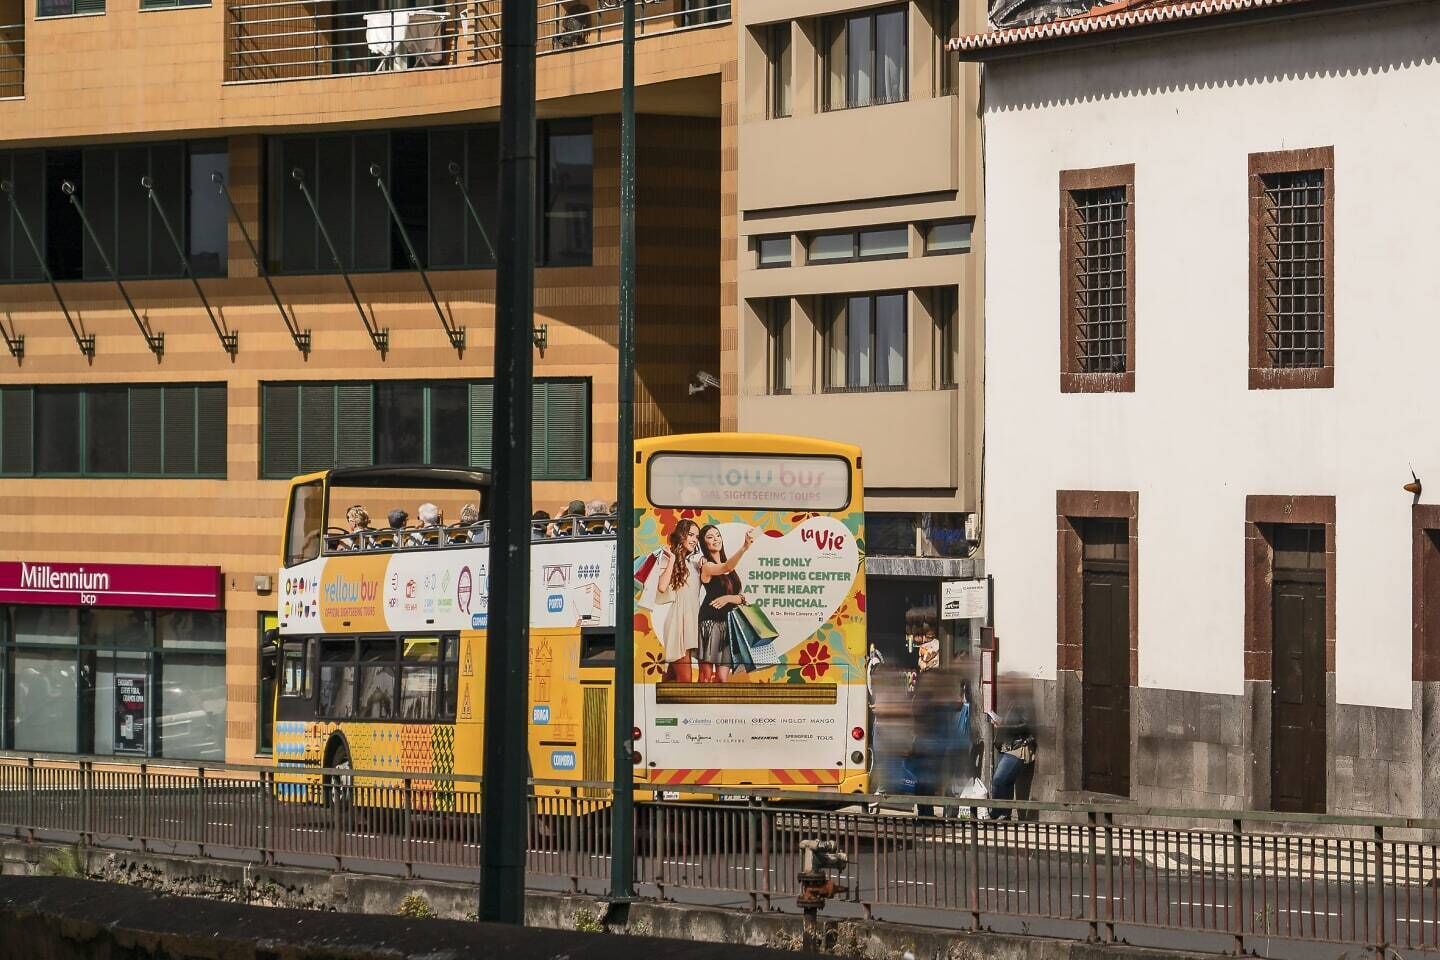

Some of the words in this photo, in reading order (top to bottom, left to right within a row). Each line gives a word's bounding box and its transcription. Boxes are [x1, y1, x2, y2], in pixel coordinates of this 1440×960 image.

[779, 461, 825, 487] bus
[723, 490, 786, 501] SIGHTSEEING
[790, 491, 822, 501] TOURS
[758, 557, 780, 567] THE
[782, 557, 812, 567] ONLY
[20, 561, 110, 590] Millennium
[748, 571, 806, 581] SHOPPING
[808, 571, 851, 581] CENTER
[324, 575, 359, 603] yellow
[361, 572, 378, 601] bus
[743, 584, 759, 594] AT
[763, 584, 785, 594] THE
[787, 584, 825, 594] HEART
[80, 592, 97, 606] bcp
[548, 598, 563, 609] PORTO
[755, 598, 771, 608] OF
[772, 598, 828, 608] FUNCHAL.
[533, 709, 549, 721] BRAGA
[552, 753, 574, 767] COIMBRA
